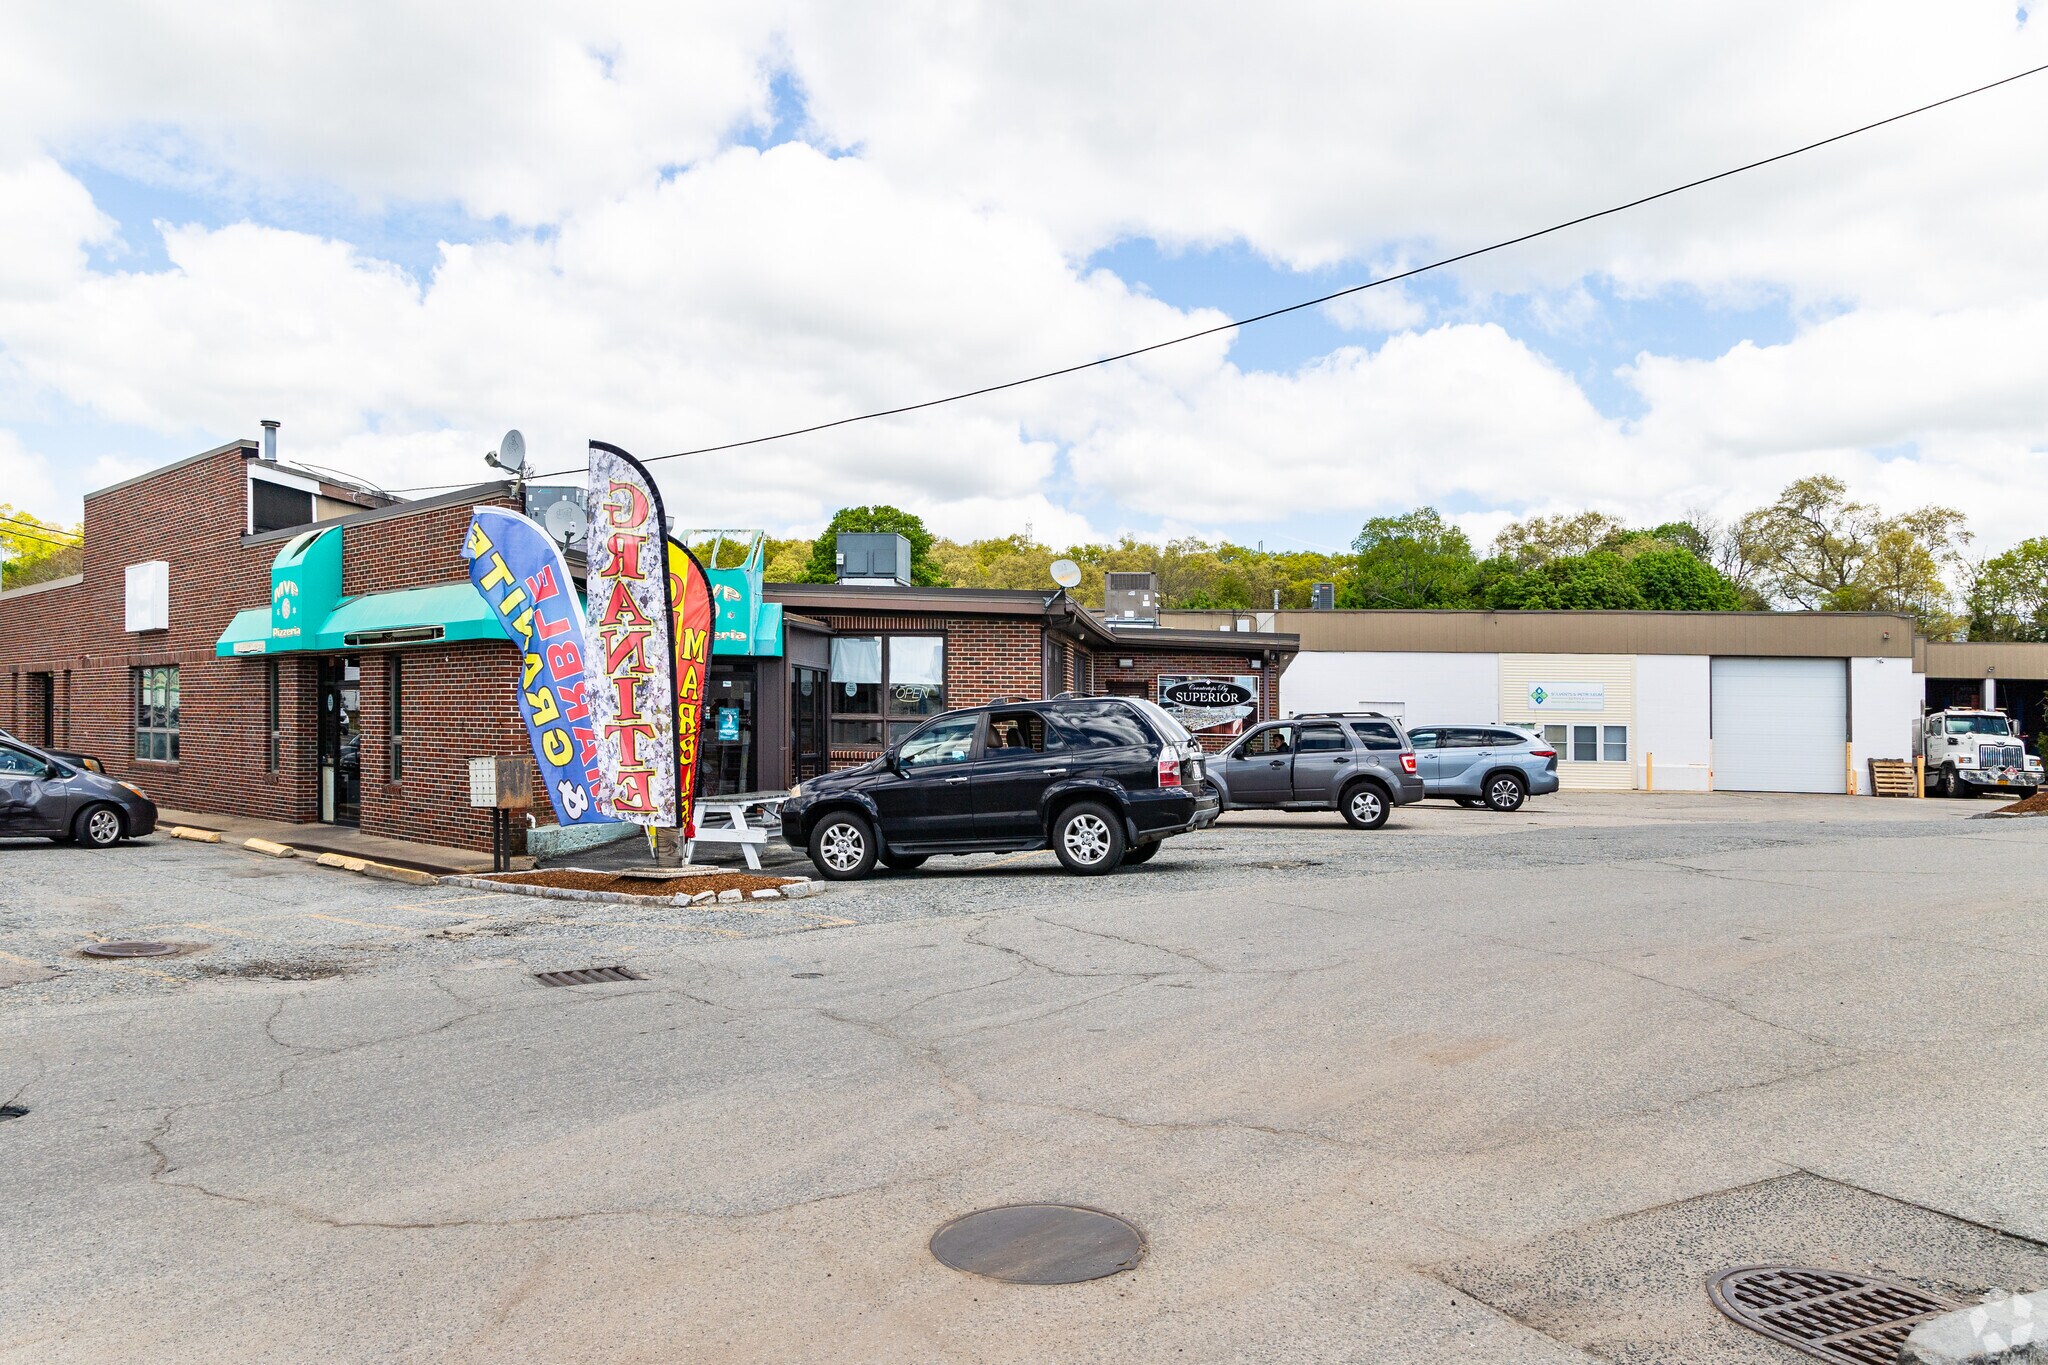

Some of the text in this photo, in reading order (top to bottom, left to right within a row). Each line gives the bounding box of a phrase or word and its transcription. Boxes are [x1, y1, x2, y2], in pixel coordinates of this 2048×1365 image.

[274, 580, 299, 603] MVP
[272, 626, 301, 638] Pizzeria
[713, 629, 747, 642] eria
[895, 687, 930, 699] OPEN
[1217, 683, 1229, 693] By
[1175, 692, 1239, 703] SUPERIOR
